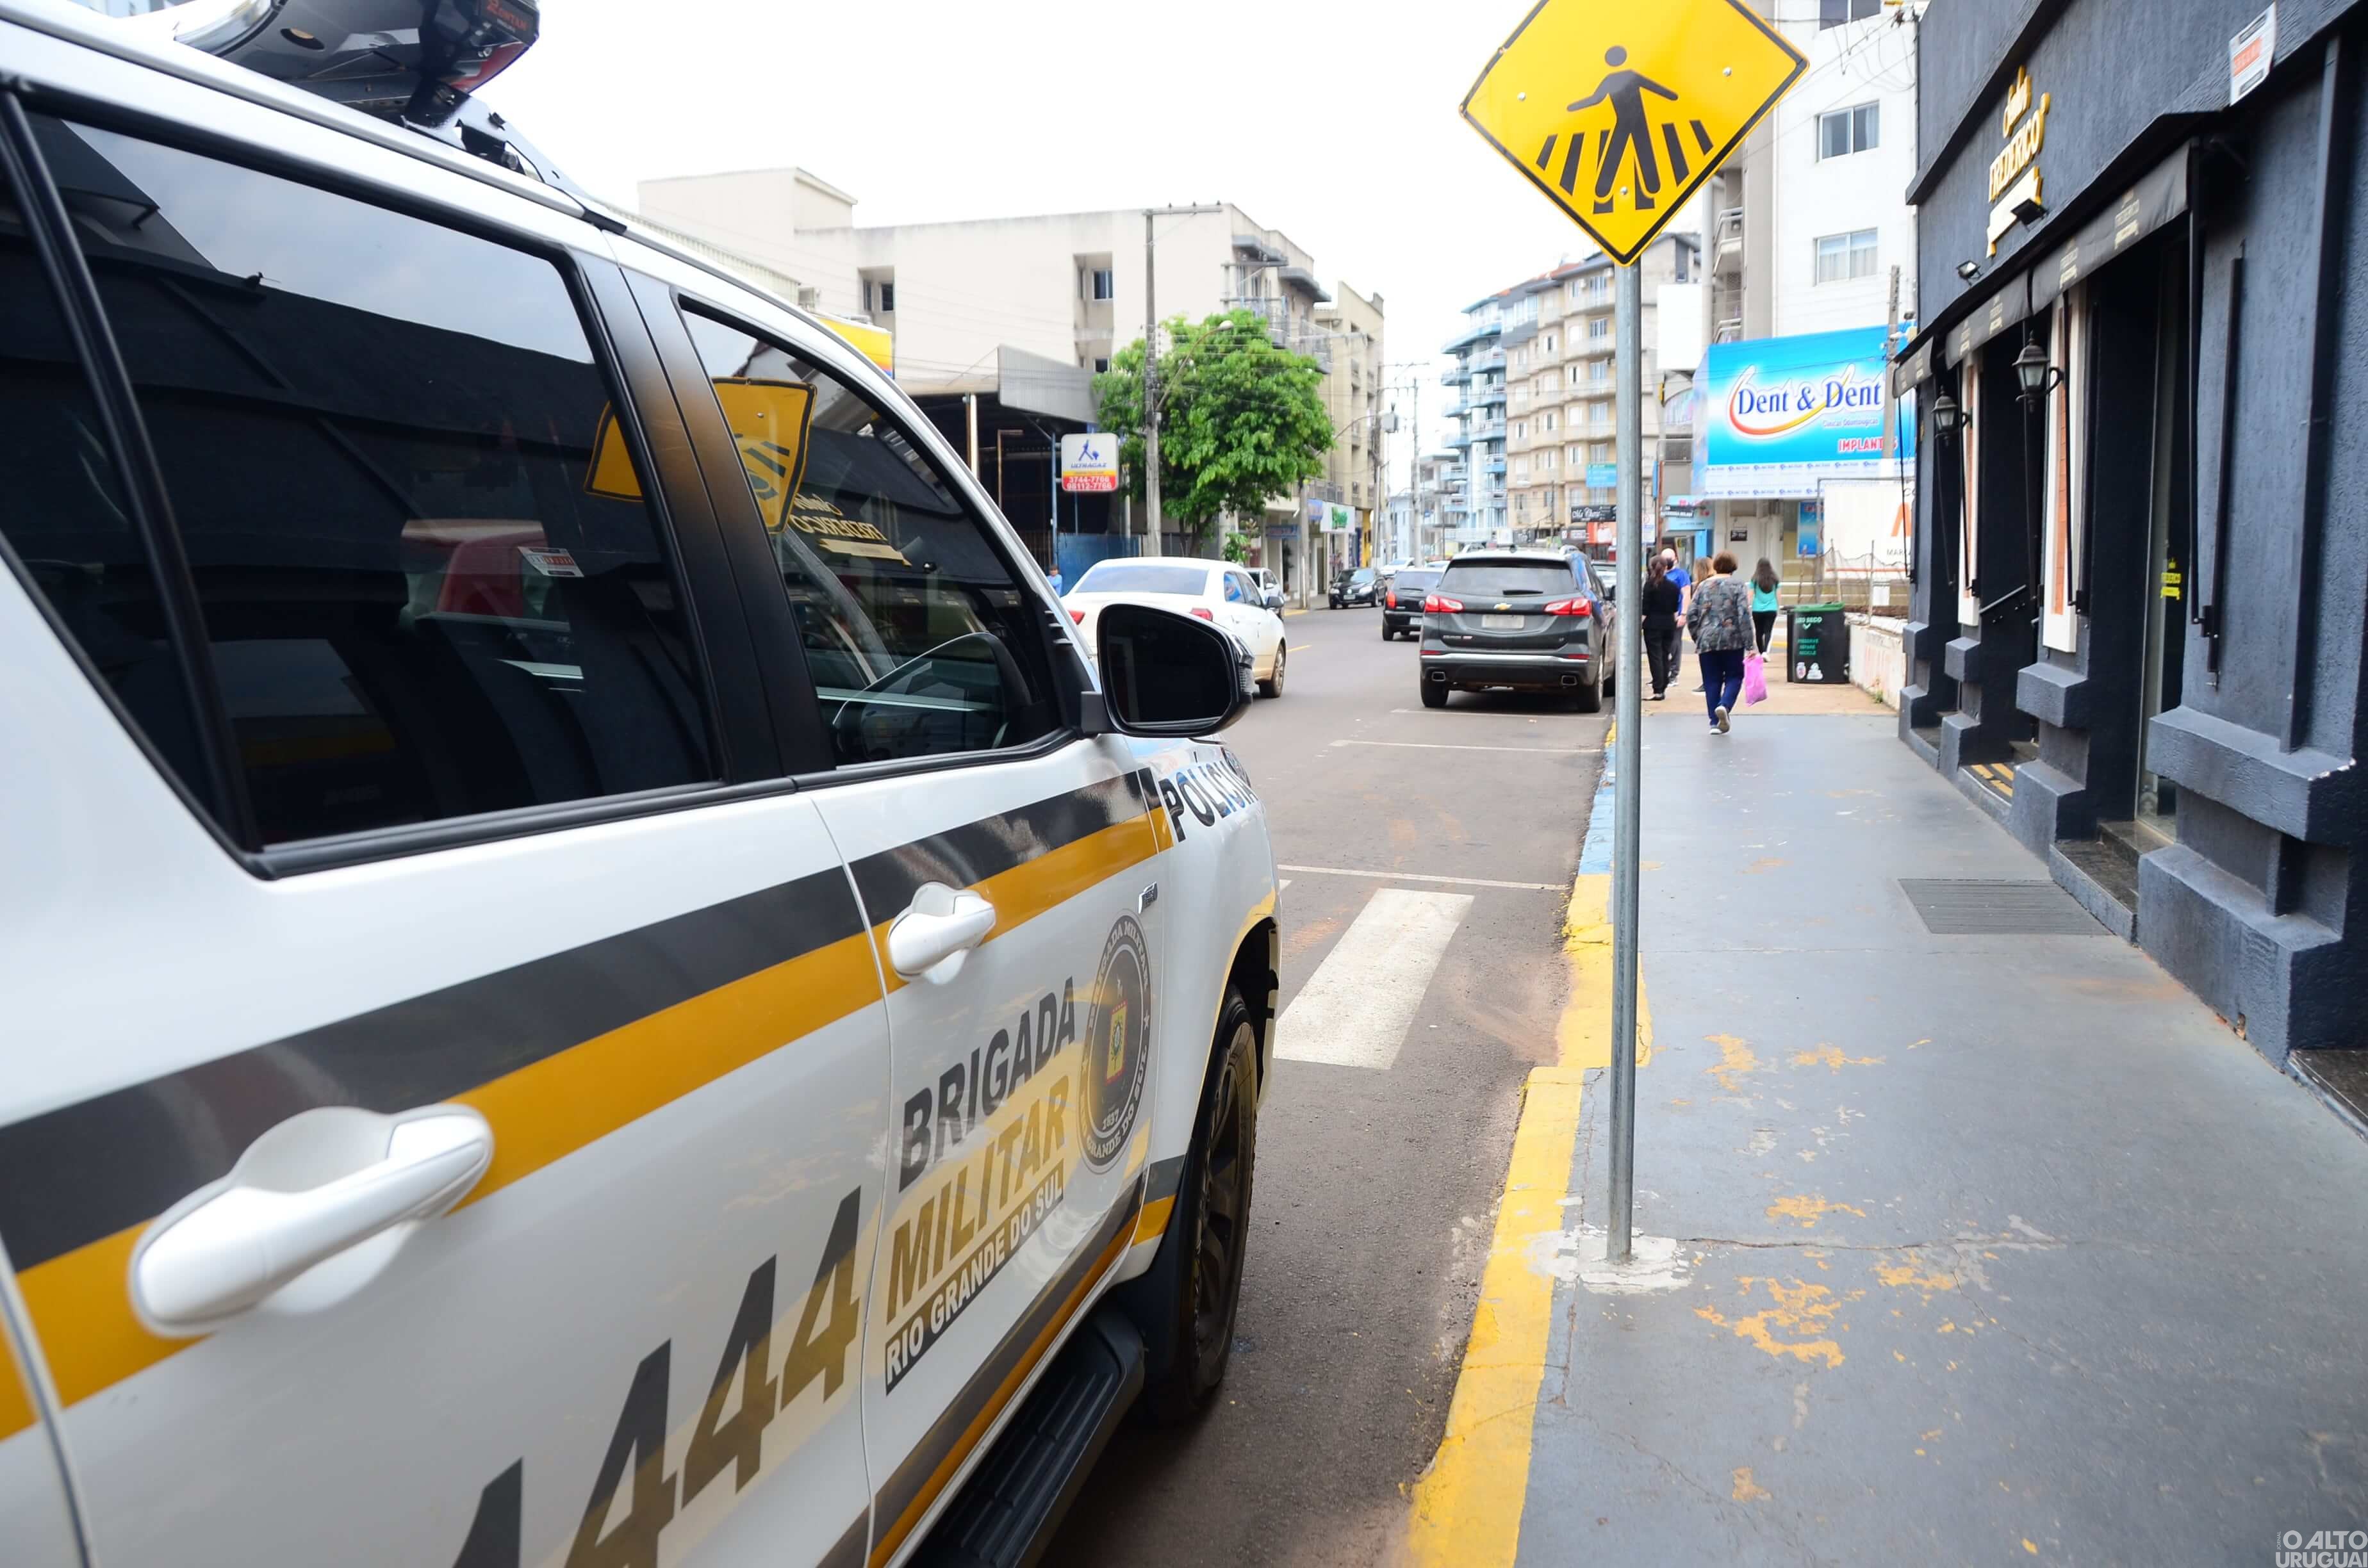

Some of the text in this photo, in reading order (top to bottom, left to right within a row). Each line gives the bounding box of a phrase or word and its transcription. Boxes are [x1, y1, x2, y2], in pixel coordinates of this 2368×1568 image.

[1738, 380, 1882, 415] Dent & Dent
[1839, 436, 1898, 452] IMPLANTS
[898, 977, 1076, 1193] BRIGADA
[1087, 1131, 1121, 1159] GRANDE
[1121, 1102, 1135, 1136] DO
[1101, 1108, 1120, 1131] 1837
[886, 1072, 1070, 1325] MILITAR
[885, 1177, 1064, 1383] RIO GRANDE DO SUL
